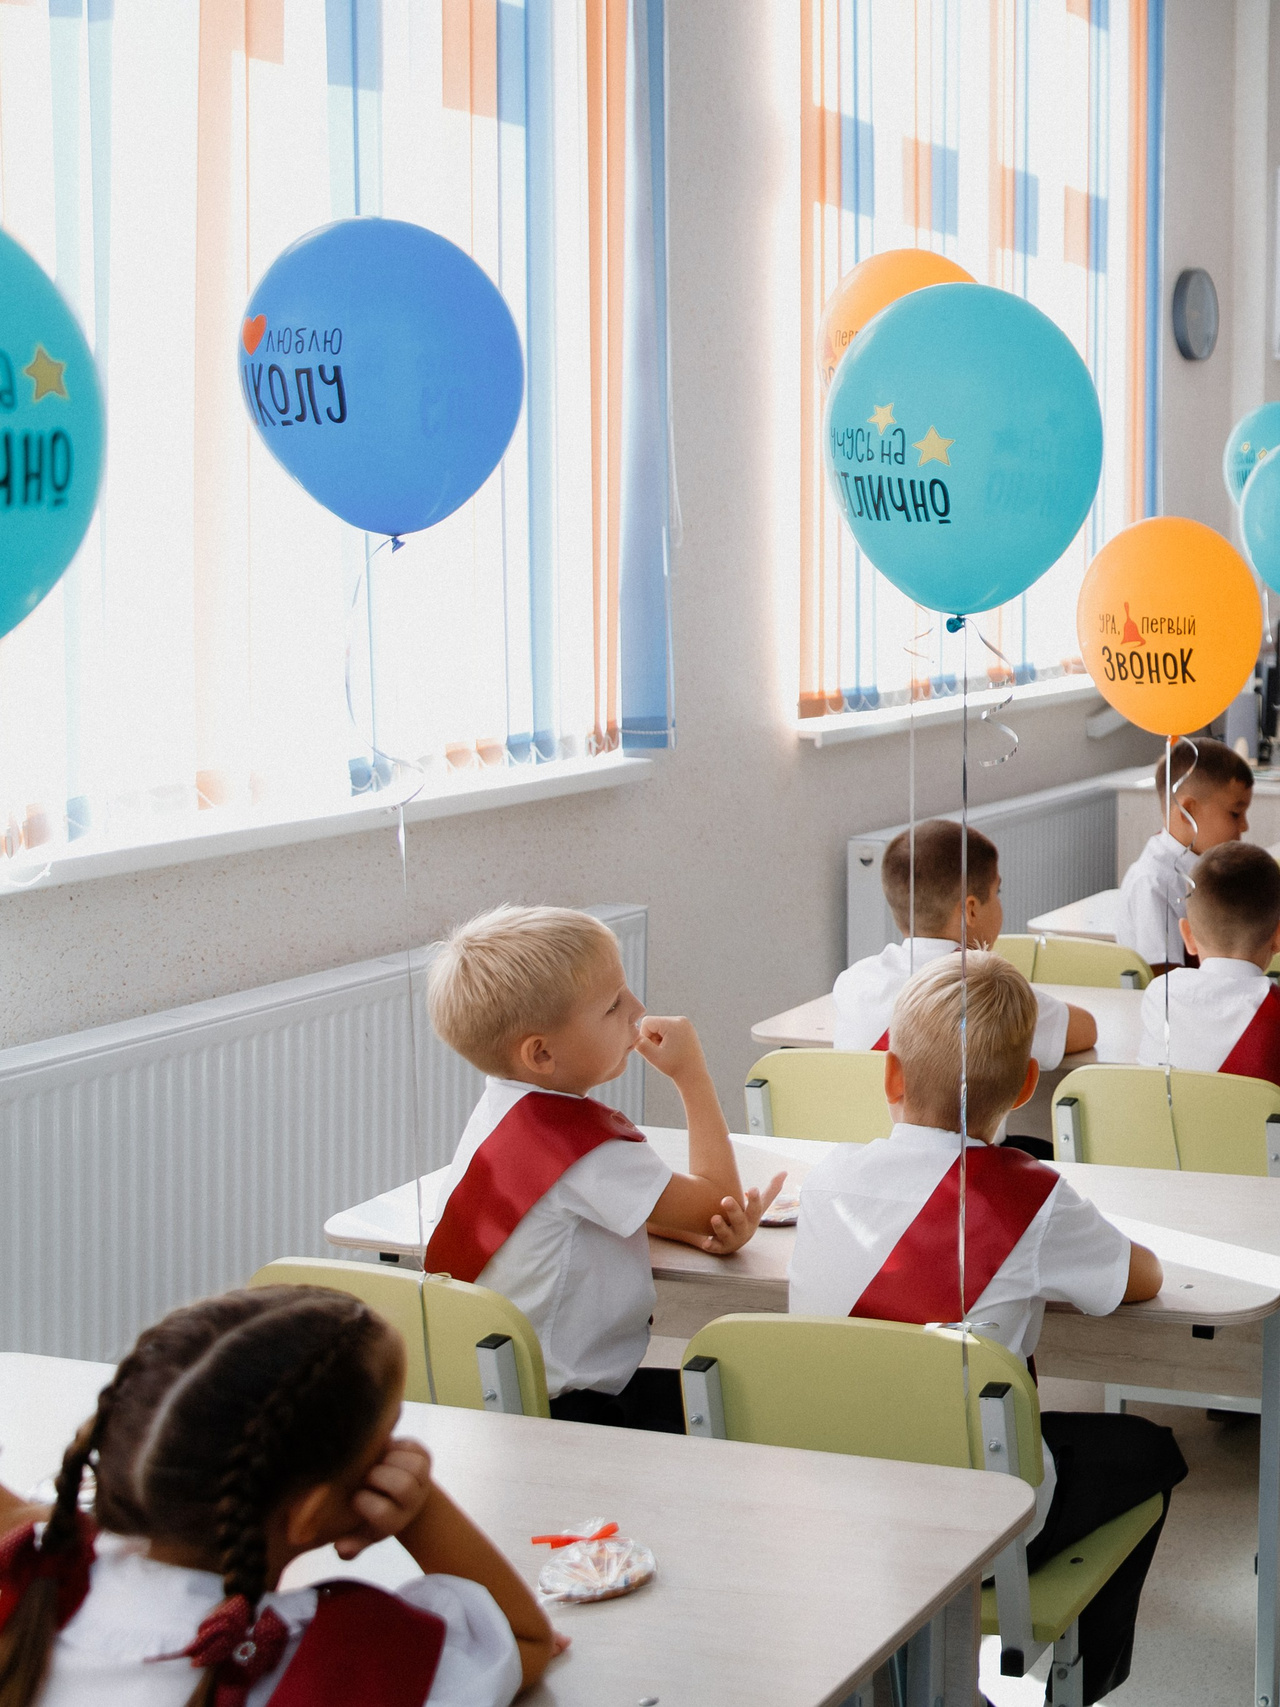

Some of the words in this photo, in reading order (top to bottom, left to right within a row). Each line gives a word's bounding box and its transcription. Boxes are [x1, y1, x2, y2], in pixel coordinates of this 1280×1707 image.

[830, 427, 875, 463] УЧУСЬ
[833, 470, 952, 525] ОТЛИЧНО
[1099, 613, 1121, 636] УРА,
[1102, 645, 1197, 685] ЗВОНОК
